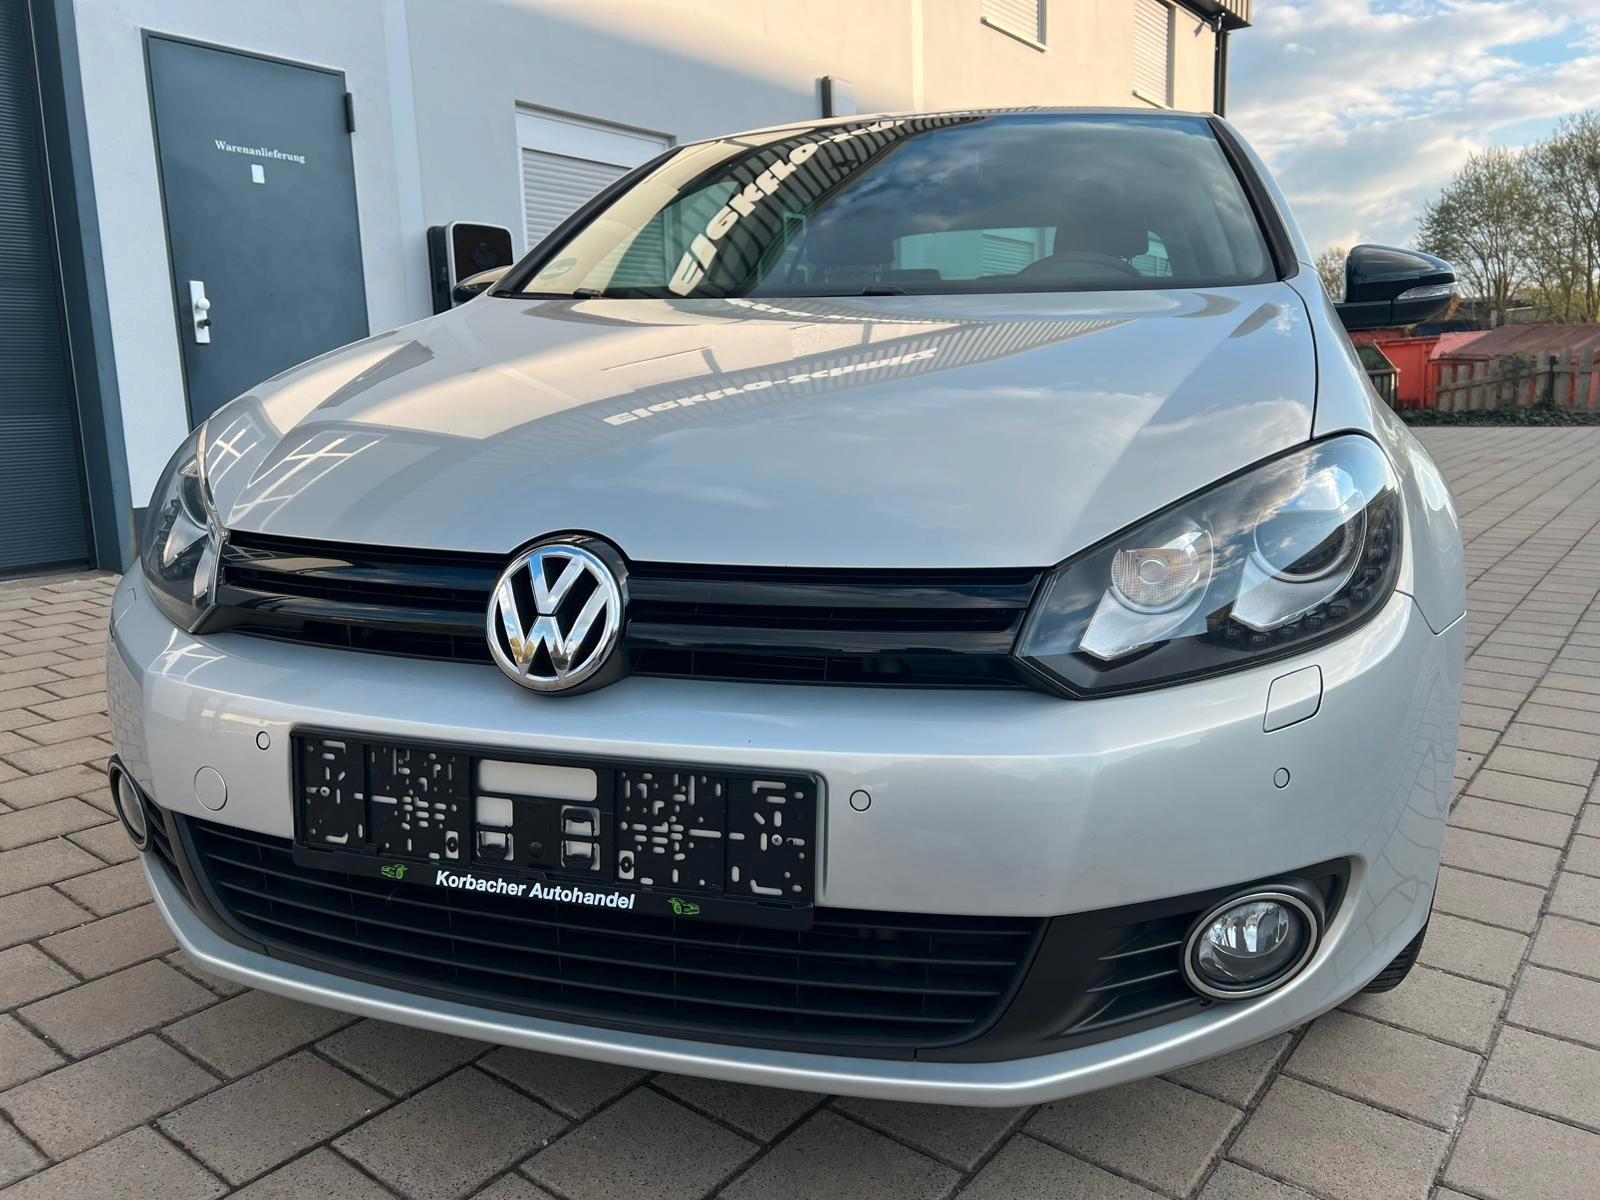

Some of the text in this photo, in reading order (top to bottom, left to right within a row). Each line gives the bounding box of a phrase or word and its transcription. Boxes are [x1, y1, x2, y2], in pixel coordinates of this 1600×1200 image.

[214, 139, 306, 164] Warenanlieferung
[496, 552, 612, 680] VW
[435, 870, 636, 910] Korbacher Autohandel
